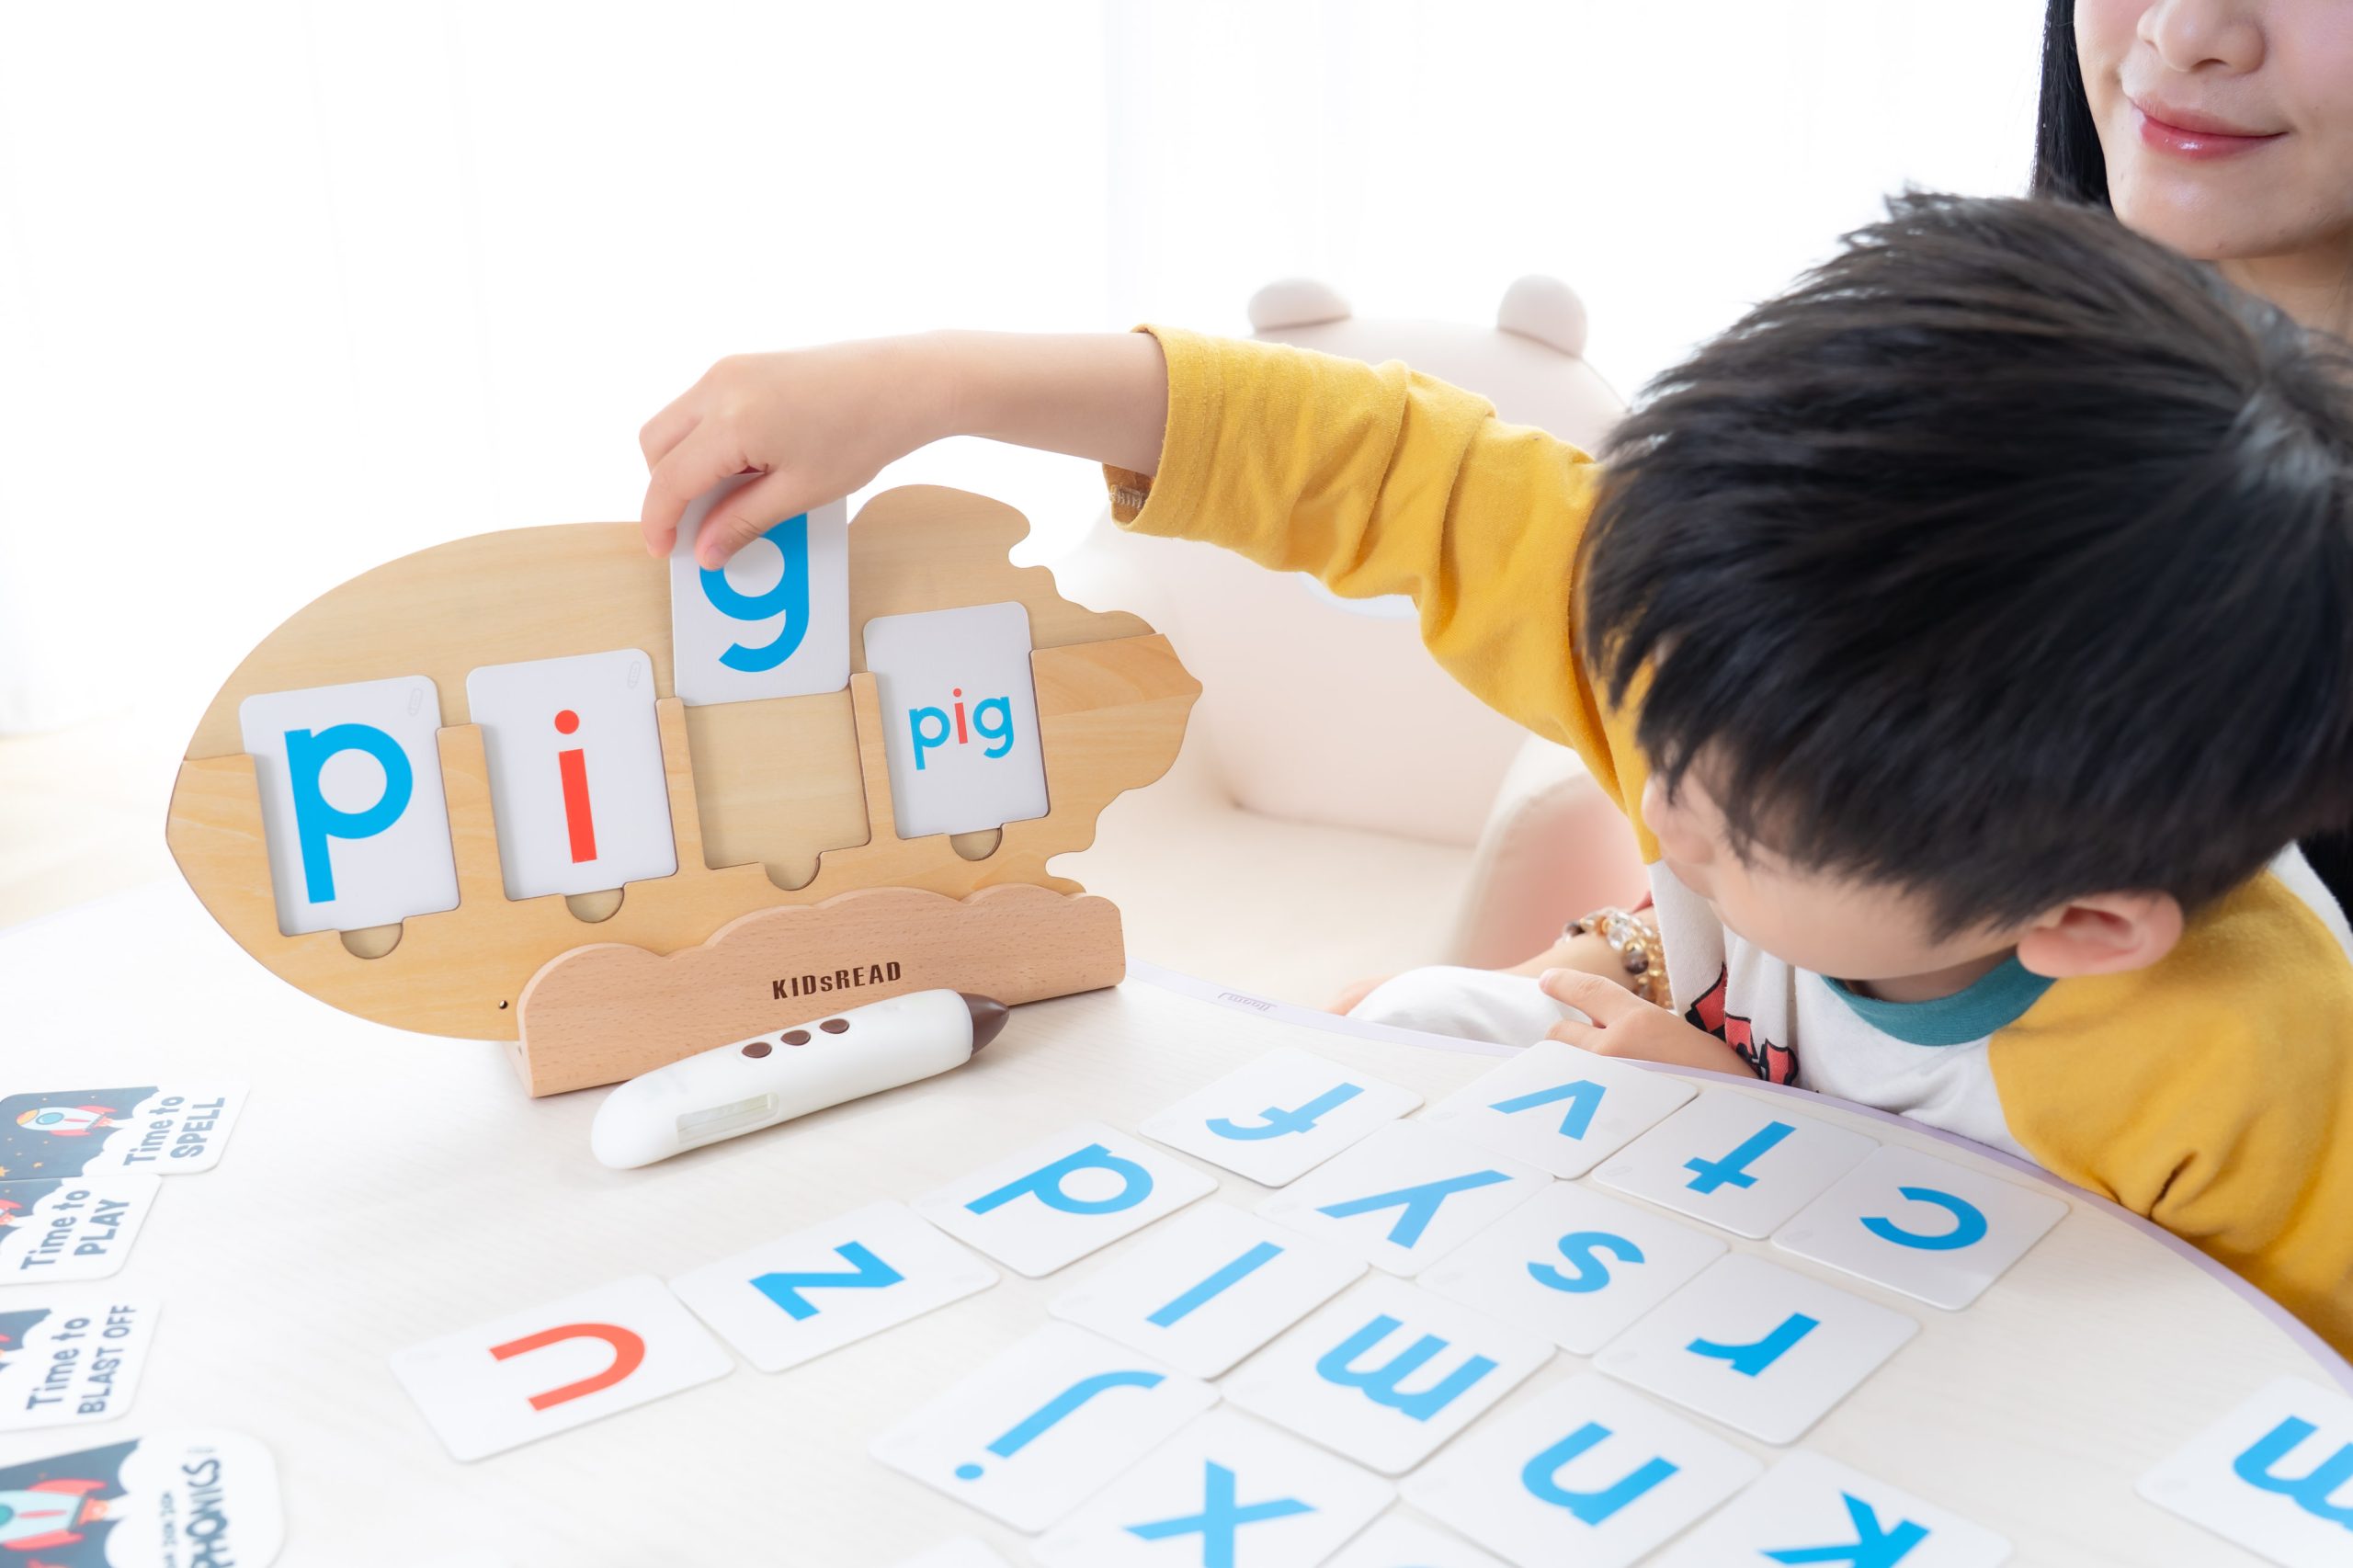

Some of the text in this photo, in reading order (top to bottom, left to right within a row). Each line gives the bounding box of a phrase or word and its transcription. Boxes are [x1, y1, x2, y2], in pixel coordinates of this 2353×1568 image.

[699, 512, 811, 674] g
[908, 687, 1016, 771] pig
[283, 722, 415, 904] p
[554, 709, 598, 865] i
[772, 961, 902, 1000] KIDsREAD
[122, 1096, 186, 1166] Time to
[169, 1097, 225, 1159] SPELL
[1205, 1082, 1364, 1142] f
[1490, 1079, 1608, 1141] v
[1682, 1120, 1797, 1196] t
[19, 1189, 91, 1270] Time to
[74, 1199, 131, 1256] PLAY
[1315, 1169, 1513, 1249] y
[1858, 1186, 1989, 1253] c
[1526, 1230, 1646, 1294] s
[26, 1317, 91, 1411] Time to
[76, 1305, 137, 1415] BLAST OFF
[1314, 1313, 1498, 1423] m
[1685, 1312, 1822, 1380] r
[953, 1369, 1166, 1482] j
[1125, 1458, 1317, 1568] x
